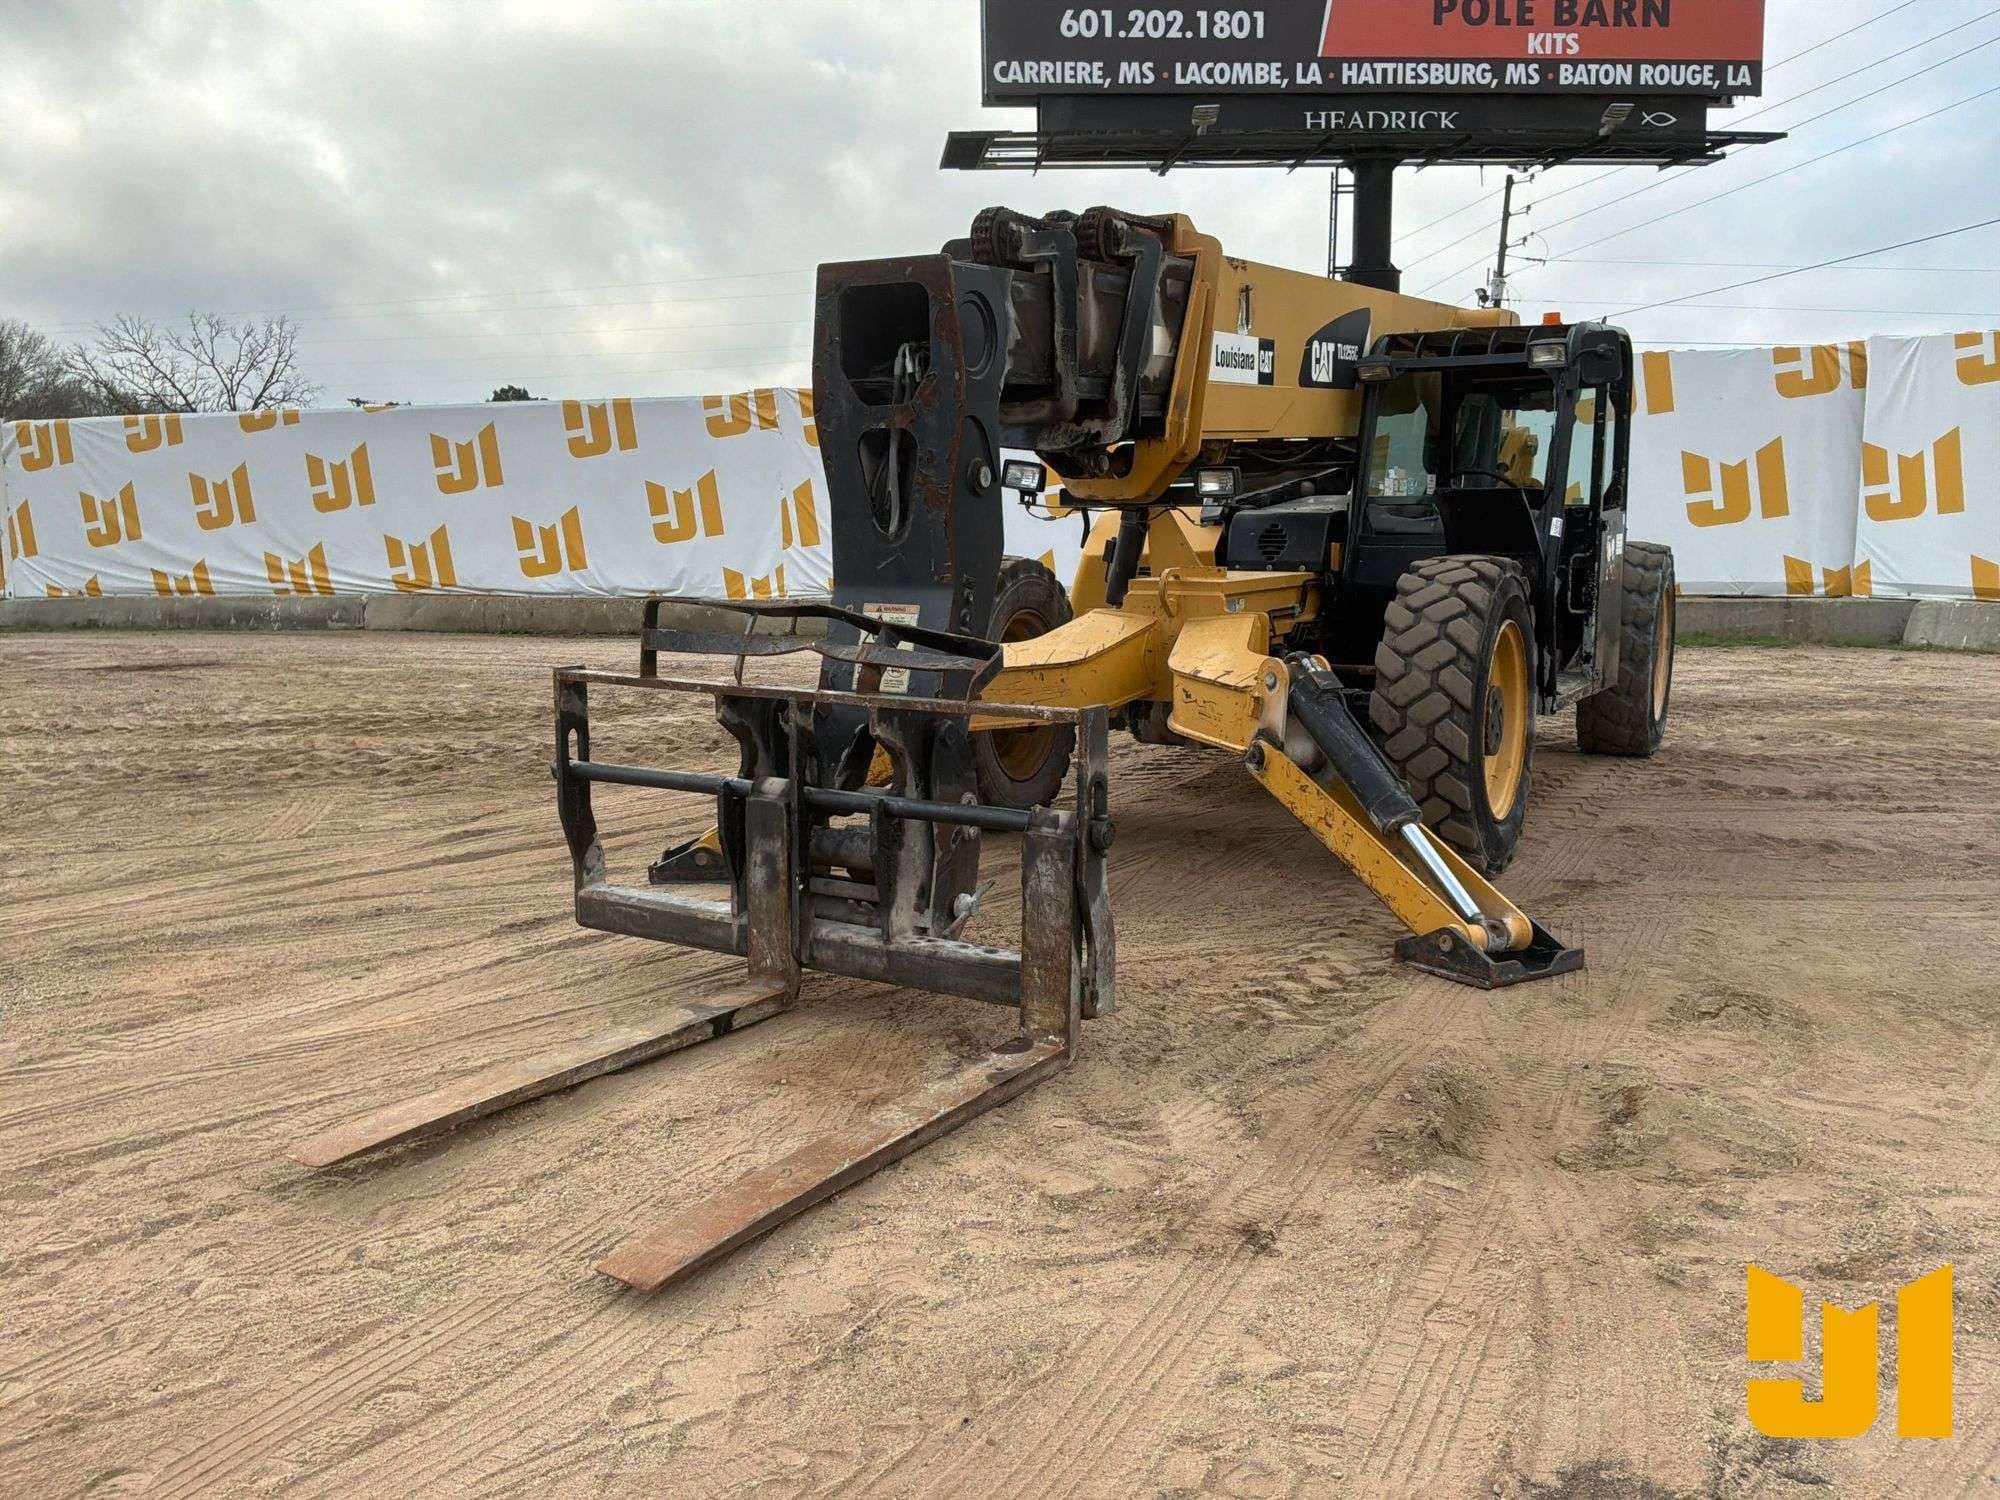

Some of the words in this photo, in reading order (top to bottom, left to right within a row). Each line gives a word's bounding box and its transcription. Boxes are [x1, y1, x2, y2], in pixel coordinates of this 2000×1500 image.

[1060, 9, 1265, 39] 601.202.1801
[1433, 0, 1535, 27] POLE
[1554, 0, 1671, 28] BARN
[1527, 32, 1581, 55] KITS
[993, 60, 1112, 89] CARRIERE,
[1118, 61, 1155, 84] MS
[1175, 62, 1289, 89] LACOMBE,
[1296, 63, 1323, 85] LA
[1341, 62, 1499, 89] HATTIESBURG,
[1504, 63, 1541, 85] MS
[1559, 64, 1632, 86] BATON
[1639, 65, 1720, 90] ROUGE,
[1727, 65, 1752, 86] LA
[1303, 110, 1460, 129] HEADRICK
[1215, 344, 1255, 371] Louisiana
[1259, 350, 1274, 374] CAT
[1311, 340, 1336, 383] CAT
